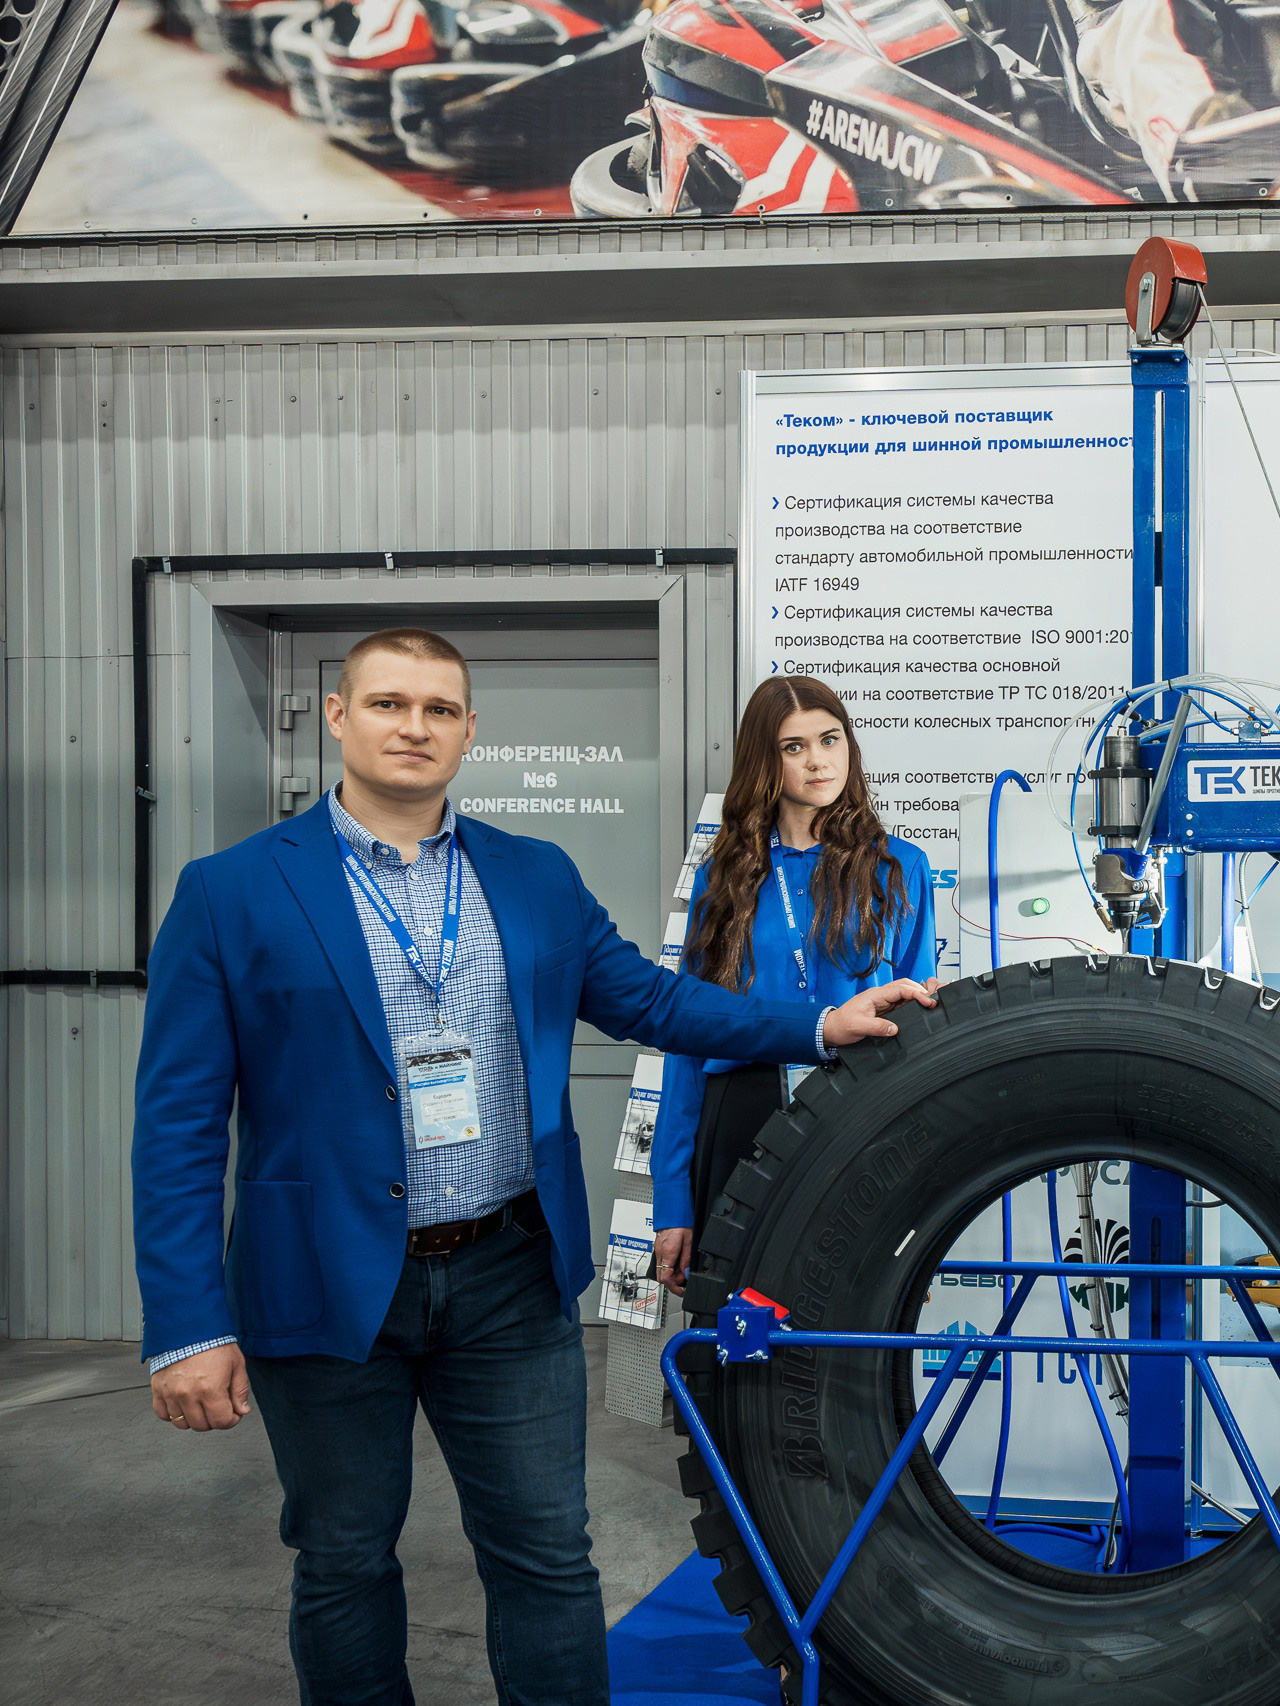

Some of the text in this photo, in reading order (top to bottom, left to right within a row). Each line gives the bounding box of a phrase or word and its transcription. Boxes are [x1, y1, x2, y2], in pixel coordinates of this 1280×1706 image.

[806, 99, 943, 185] #ARENAJCW
[775, 413, 843, 428] «Теком»
[861, 409, 949, 426] ключевой
[954, 410, 1054, 424] поставщик
[775, 442, 869, 458] продукции
[874, 441, 907, 456] для
[912, 436, 982, 452] шинной
[784, 493, 1054, 513] Сертификация системы качества
[775, 522, 1023, 541] производства на соответствие
[775, 552, 855, 567] стандарту
[859, 547, 984, 564] автомобильной
[775, 576, 860, 592] IATF 16949
[784, 604, 1053, 623] Сертификация системы качества
[775, 629, 1133, 650] производства на соответствие ISO 9001:20
[783, 657, 1060, 677] Сертификация качества основной
[862, 689, 882, 701] на
[885, 689, 994, 701] соответствие
[997, 685, 1020, 700] ТР
[1024, 685, 1048, 700] ТС
[914, 717, 992, 729] колесных
[461, 745, 624, 765] КОНФЕРЕНЦ-ЗАЛ
[523, 771, 558, 789] №6
[460, 797, 625, 814] CONFERENCE HALL
